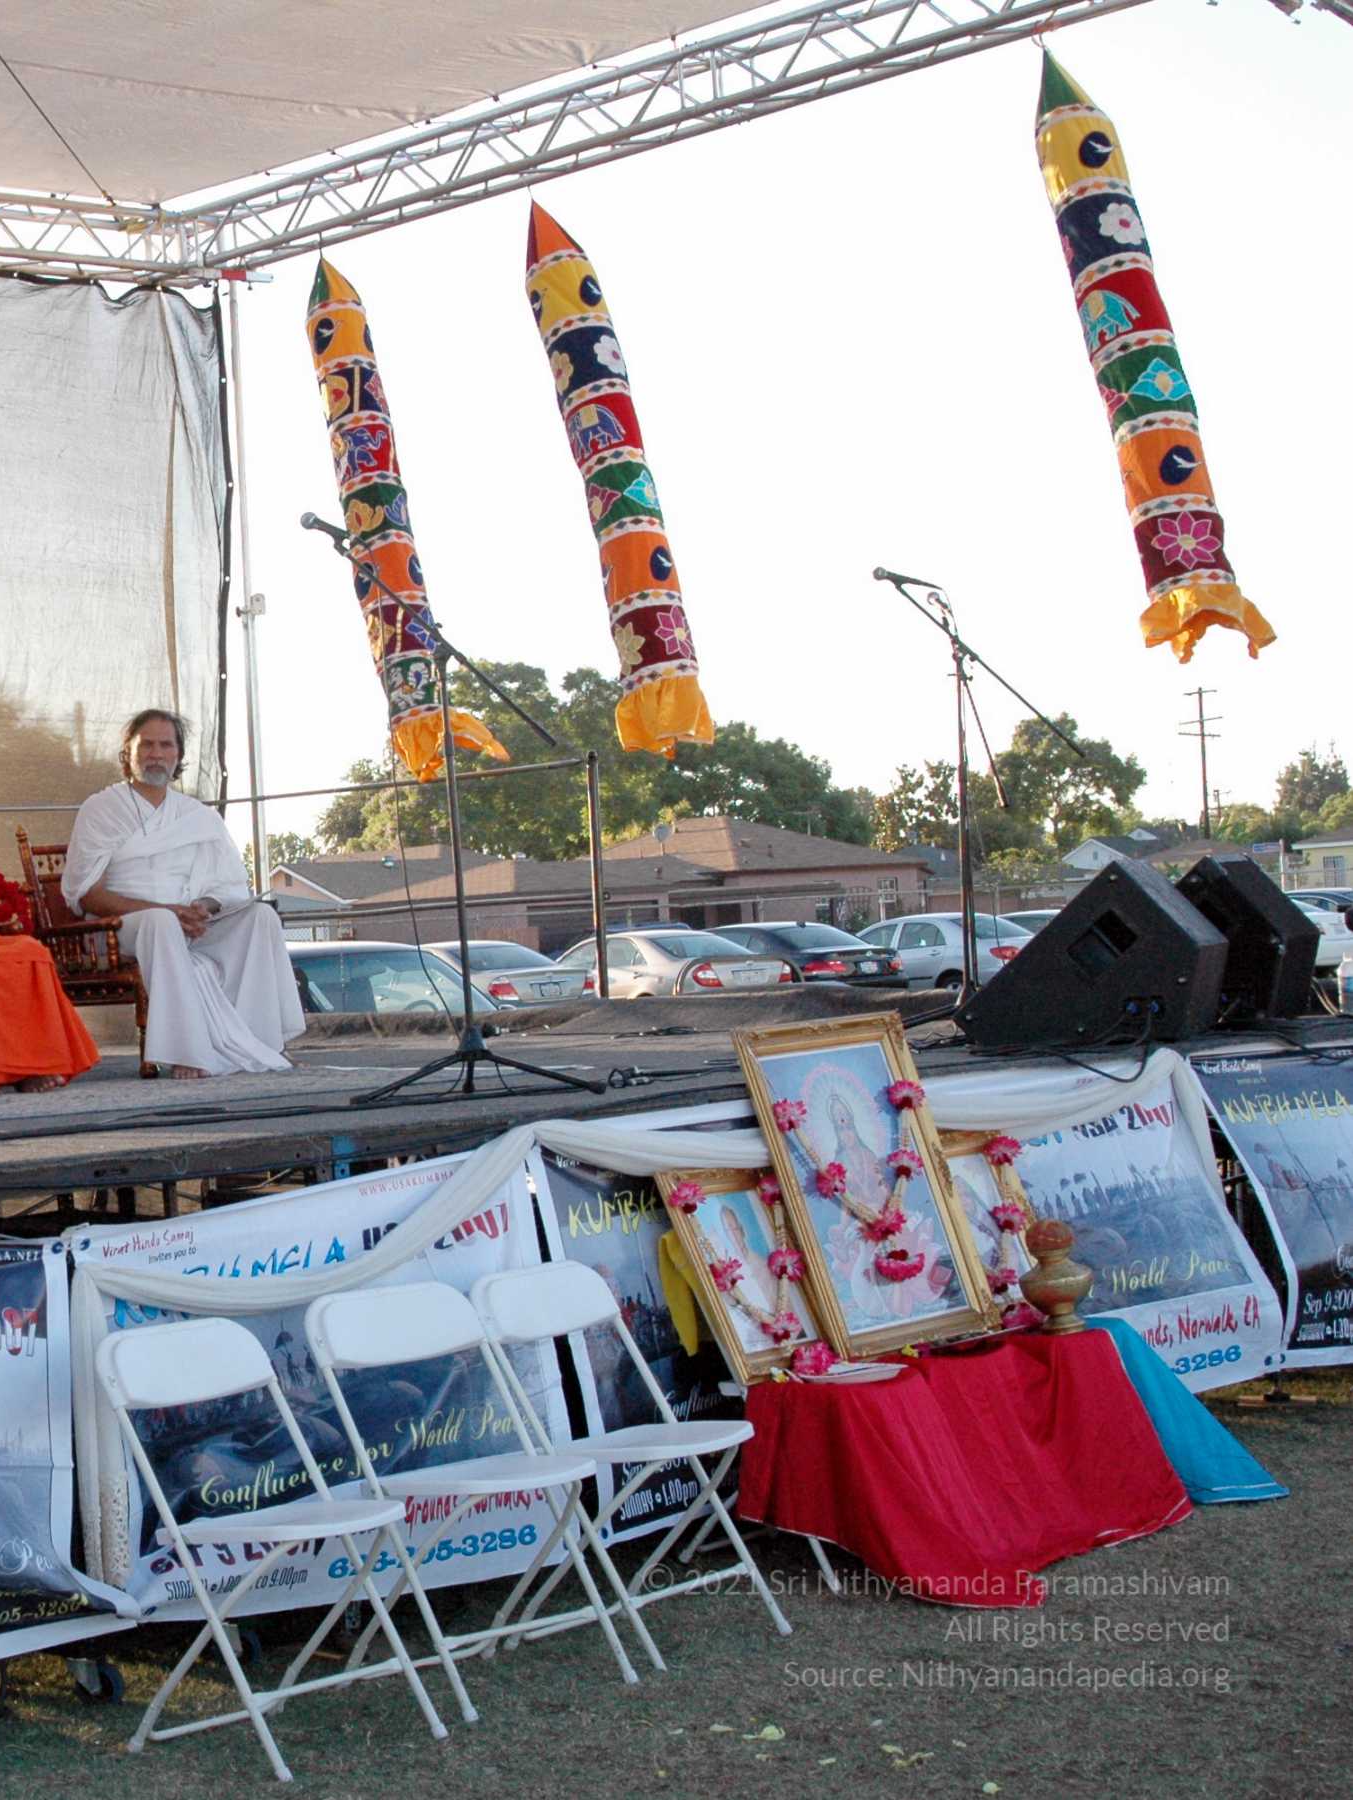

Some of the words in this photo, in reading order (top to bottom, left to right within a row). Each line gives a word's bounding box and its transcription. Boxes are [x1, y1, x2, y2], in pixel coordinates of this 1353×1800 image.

[103, 1240, 130, 1258] Virat
[133, 1231, 160, 1252] Hindu
[163, 1227, 194, 1245] Samaj
[1102, 1255, 1170, 1293] World
[1178, 1304, 1239, 1344] Norwalk,
[1243, 1294, 1262, 1329] CA
[395, 1407, 466, 1451] World
